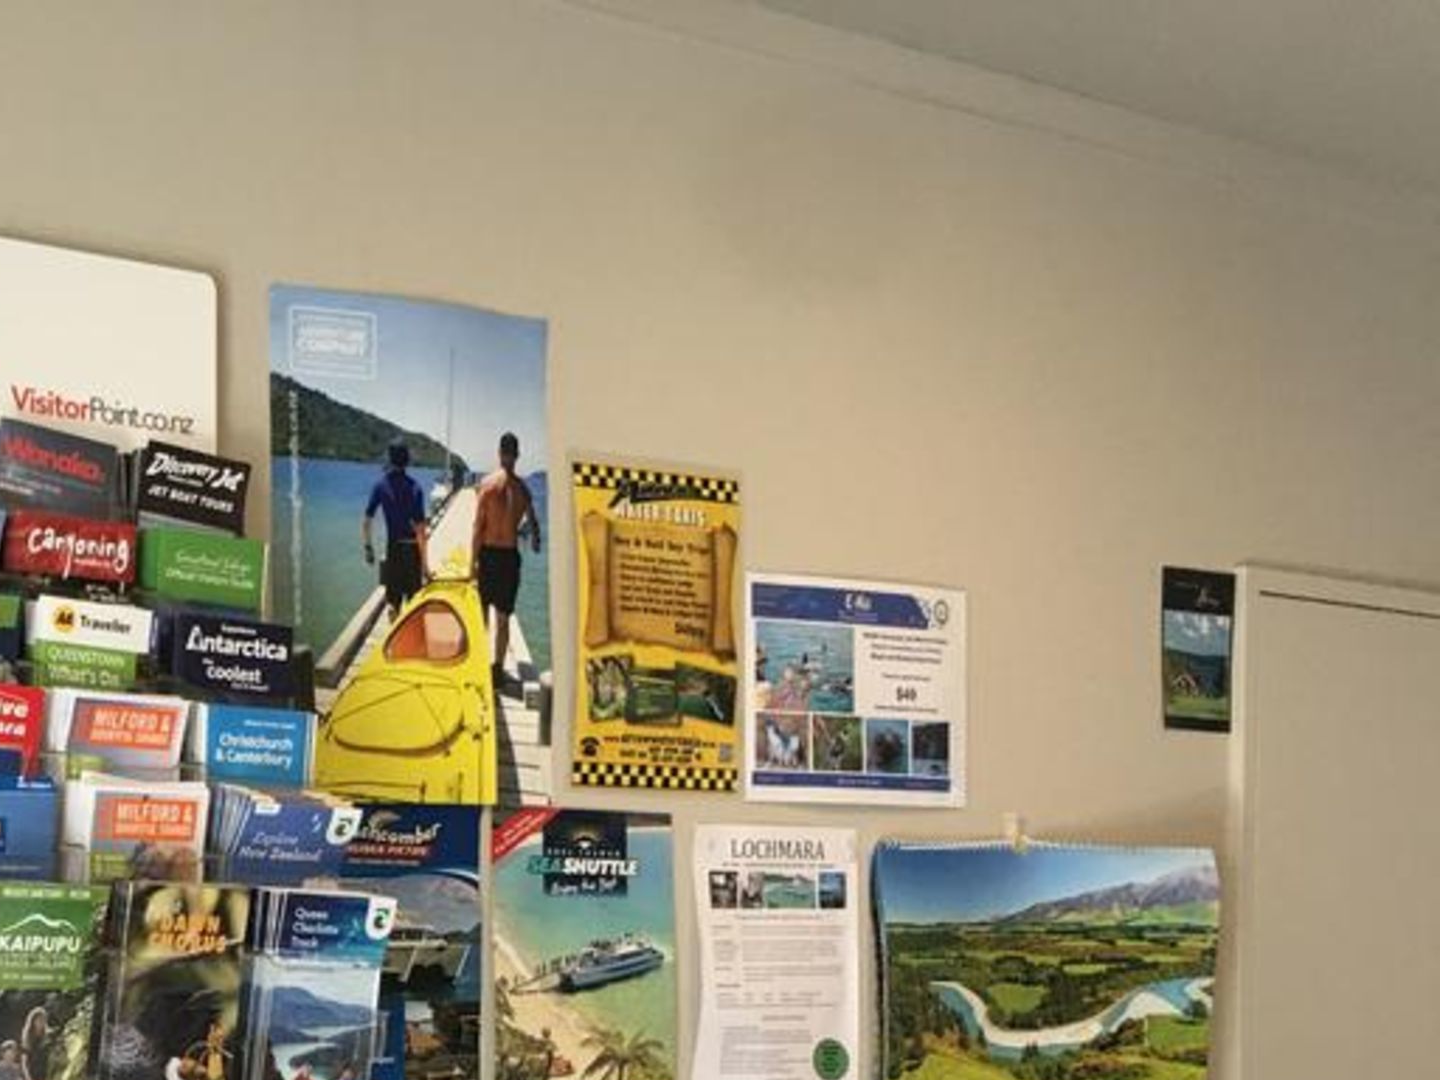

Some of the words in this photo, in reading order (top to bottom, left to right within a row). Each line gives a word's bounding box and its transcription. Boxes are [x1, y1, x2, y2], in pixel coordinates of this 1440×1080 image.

[11, 385, 194, 435] VisitorPoint.co.nz
[146, 452, 218, 482] Discovery
[80, 615, 131, 635] Traveller
[186, 625, 288, 661] Antarctica
[206, 666, 261, 684] coolest
[93, 708, 158, 731] MILFORD
[219, 732, 293, 751] Christchurch
[226, 751, 292, 769] Canterbury
[117, 804, 180, 823] MILFORD
[730, 838, 826, 860] LOCHMARA
[160, 915, 219, 934] DAWN
[148, 932, 226, 953] CHORUS
